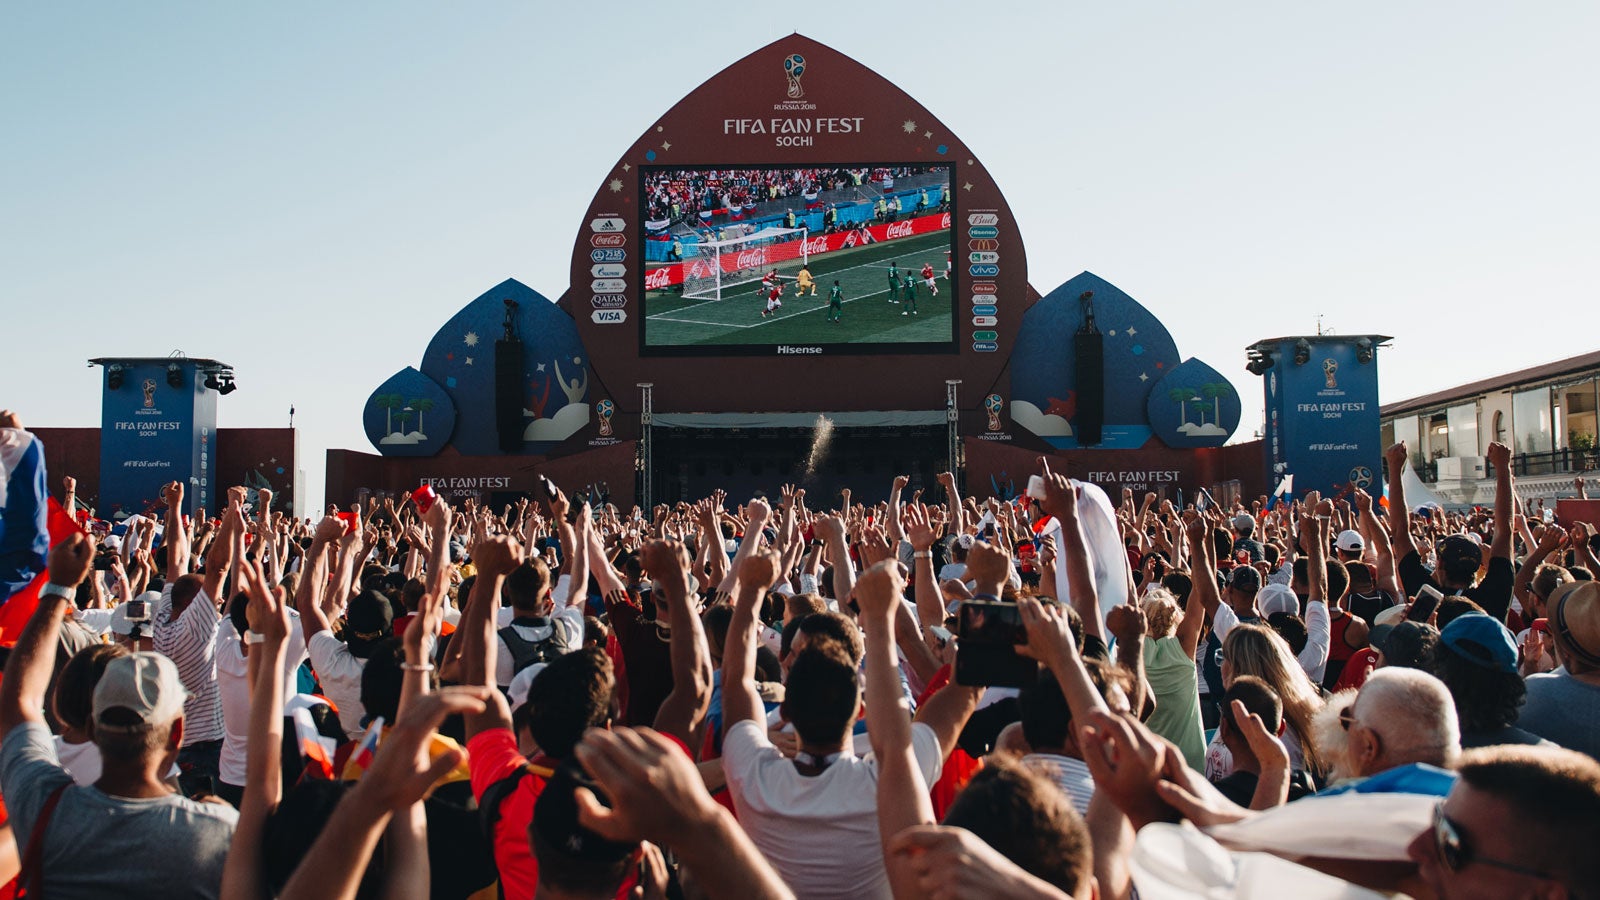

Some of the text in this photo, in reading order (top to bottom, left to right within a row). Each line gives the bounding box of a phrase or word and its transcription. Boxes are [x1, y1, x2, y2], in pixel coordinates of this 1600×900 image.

[724, 117, 864, 134] FIFA FAN FEST
[776, 136, 813, 147] SOCHI
[973, 215, 995, 225] Bud
[594, 295, 622, 304] QATAR
[598, 312, 621, 321] VISA
[777, 345, 823, 354] Hisense
[1297, 402, 1366, 412] FIFA FAN FEST
[115, 421, 181, 430] FIFA FAN FEST
[1088, 470, 1180, 482] FIFA FAN FEST
[420, 477, 511, 488] FIFA FAN FEST
